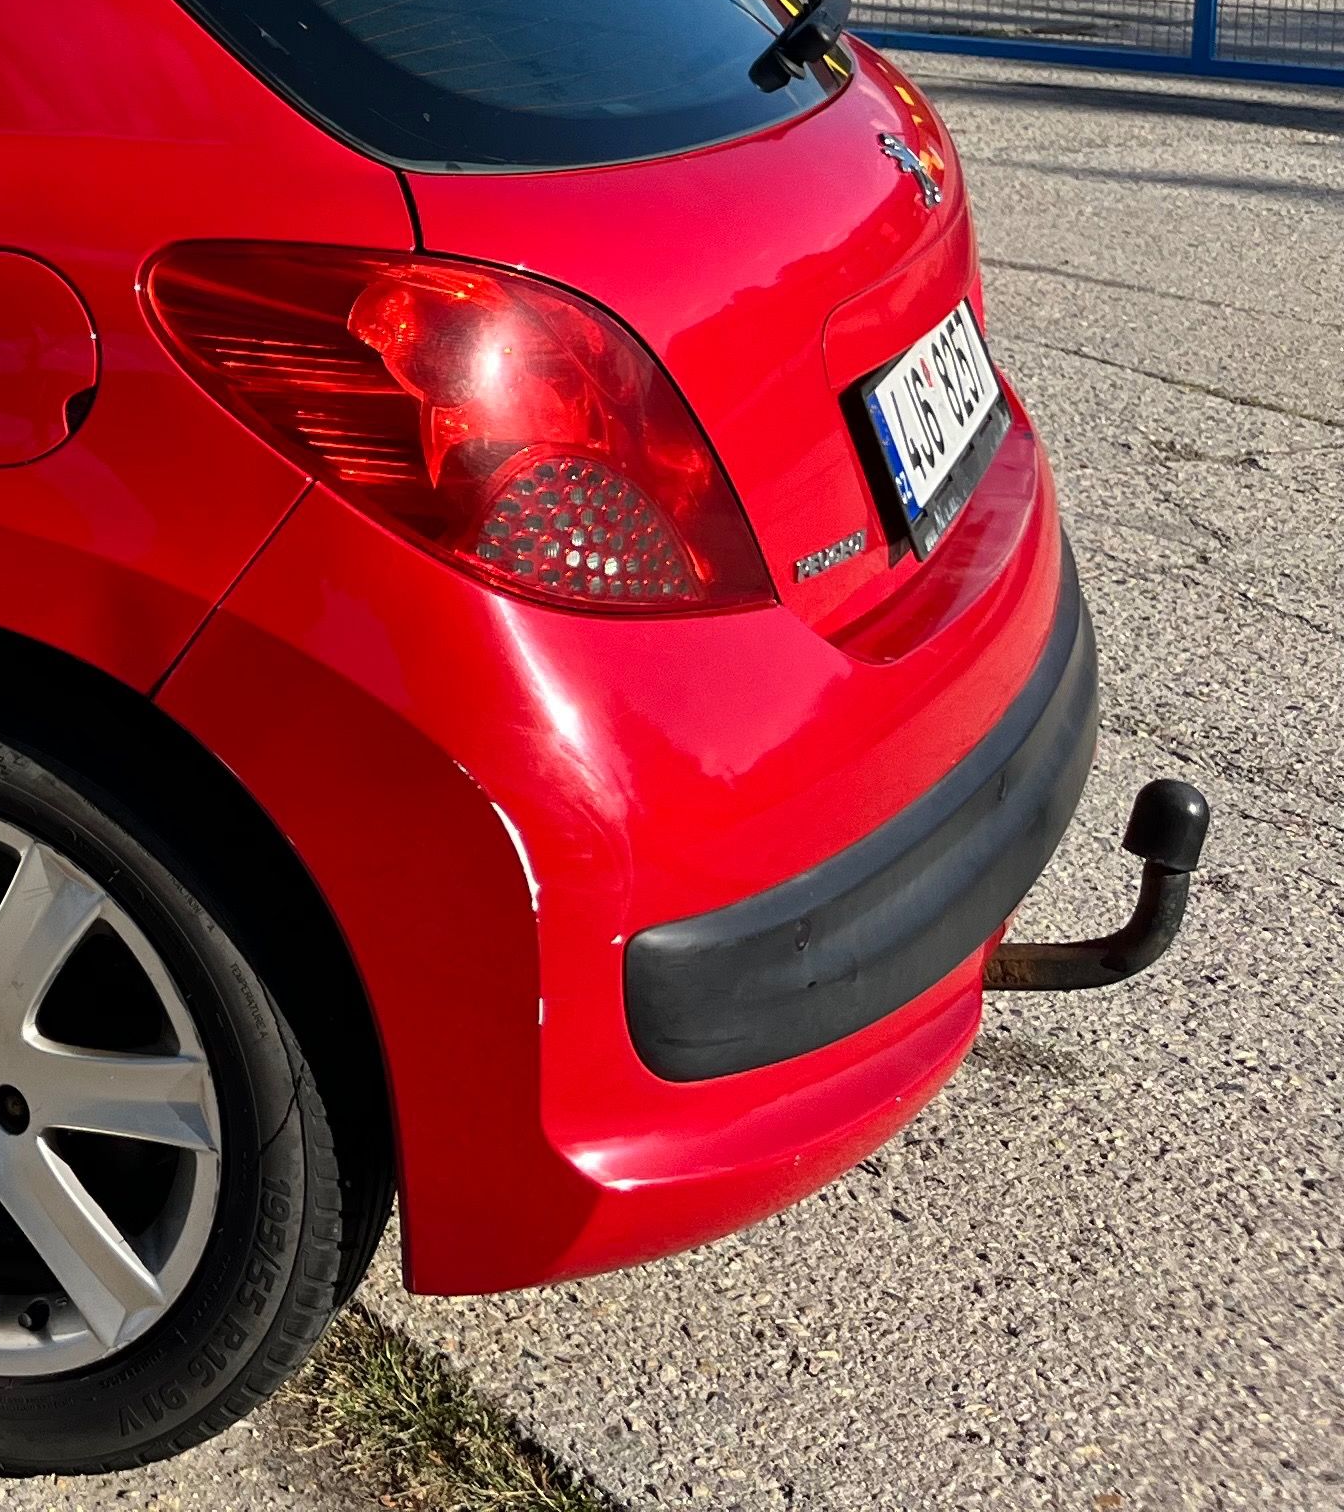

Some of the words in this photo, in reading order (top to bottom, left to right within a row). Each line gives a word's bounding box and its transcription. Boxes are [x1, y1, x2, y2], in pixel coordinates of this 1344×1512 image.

[931, 309, 986, 427] 8257
[230, 961, 266, 1031] TEMPERATURE
[237, 1177, 291, 1317] 195/55
